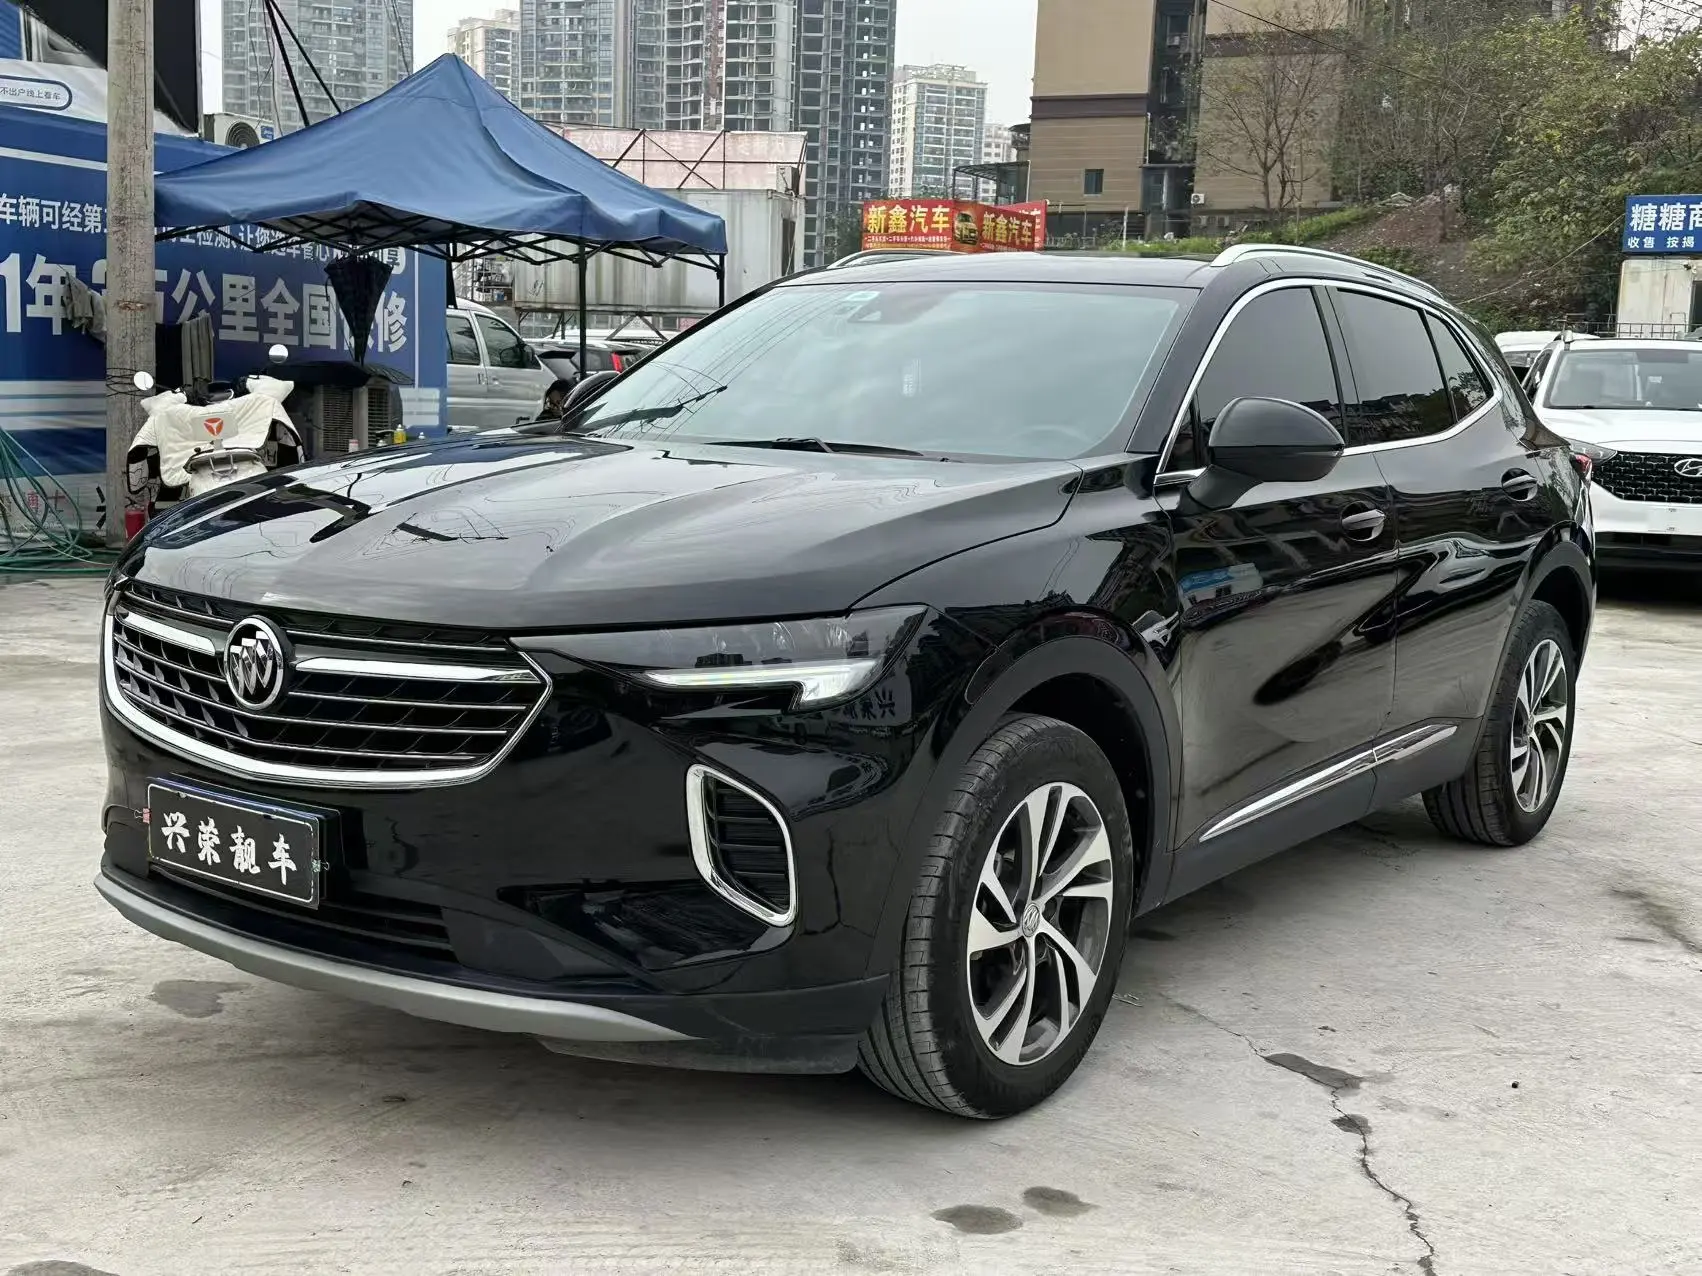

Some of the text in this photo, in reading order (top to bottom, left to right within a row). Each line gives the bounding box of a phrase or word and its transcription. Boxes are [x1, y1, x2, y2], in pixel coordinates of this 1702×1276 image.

[867, 204, 950, 233] 新鑫汽车
[1628, 236, 1695, 249] 收售 按揭
[161, 811, 297, 886] 兴荣靓车
